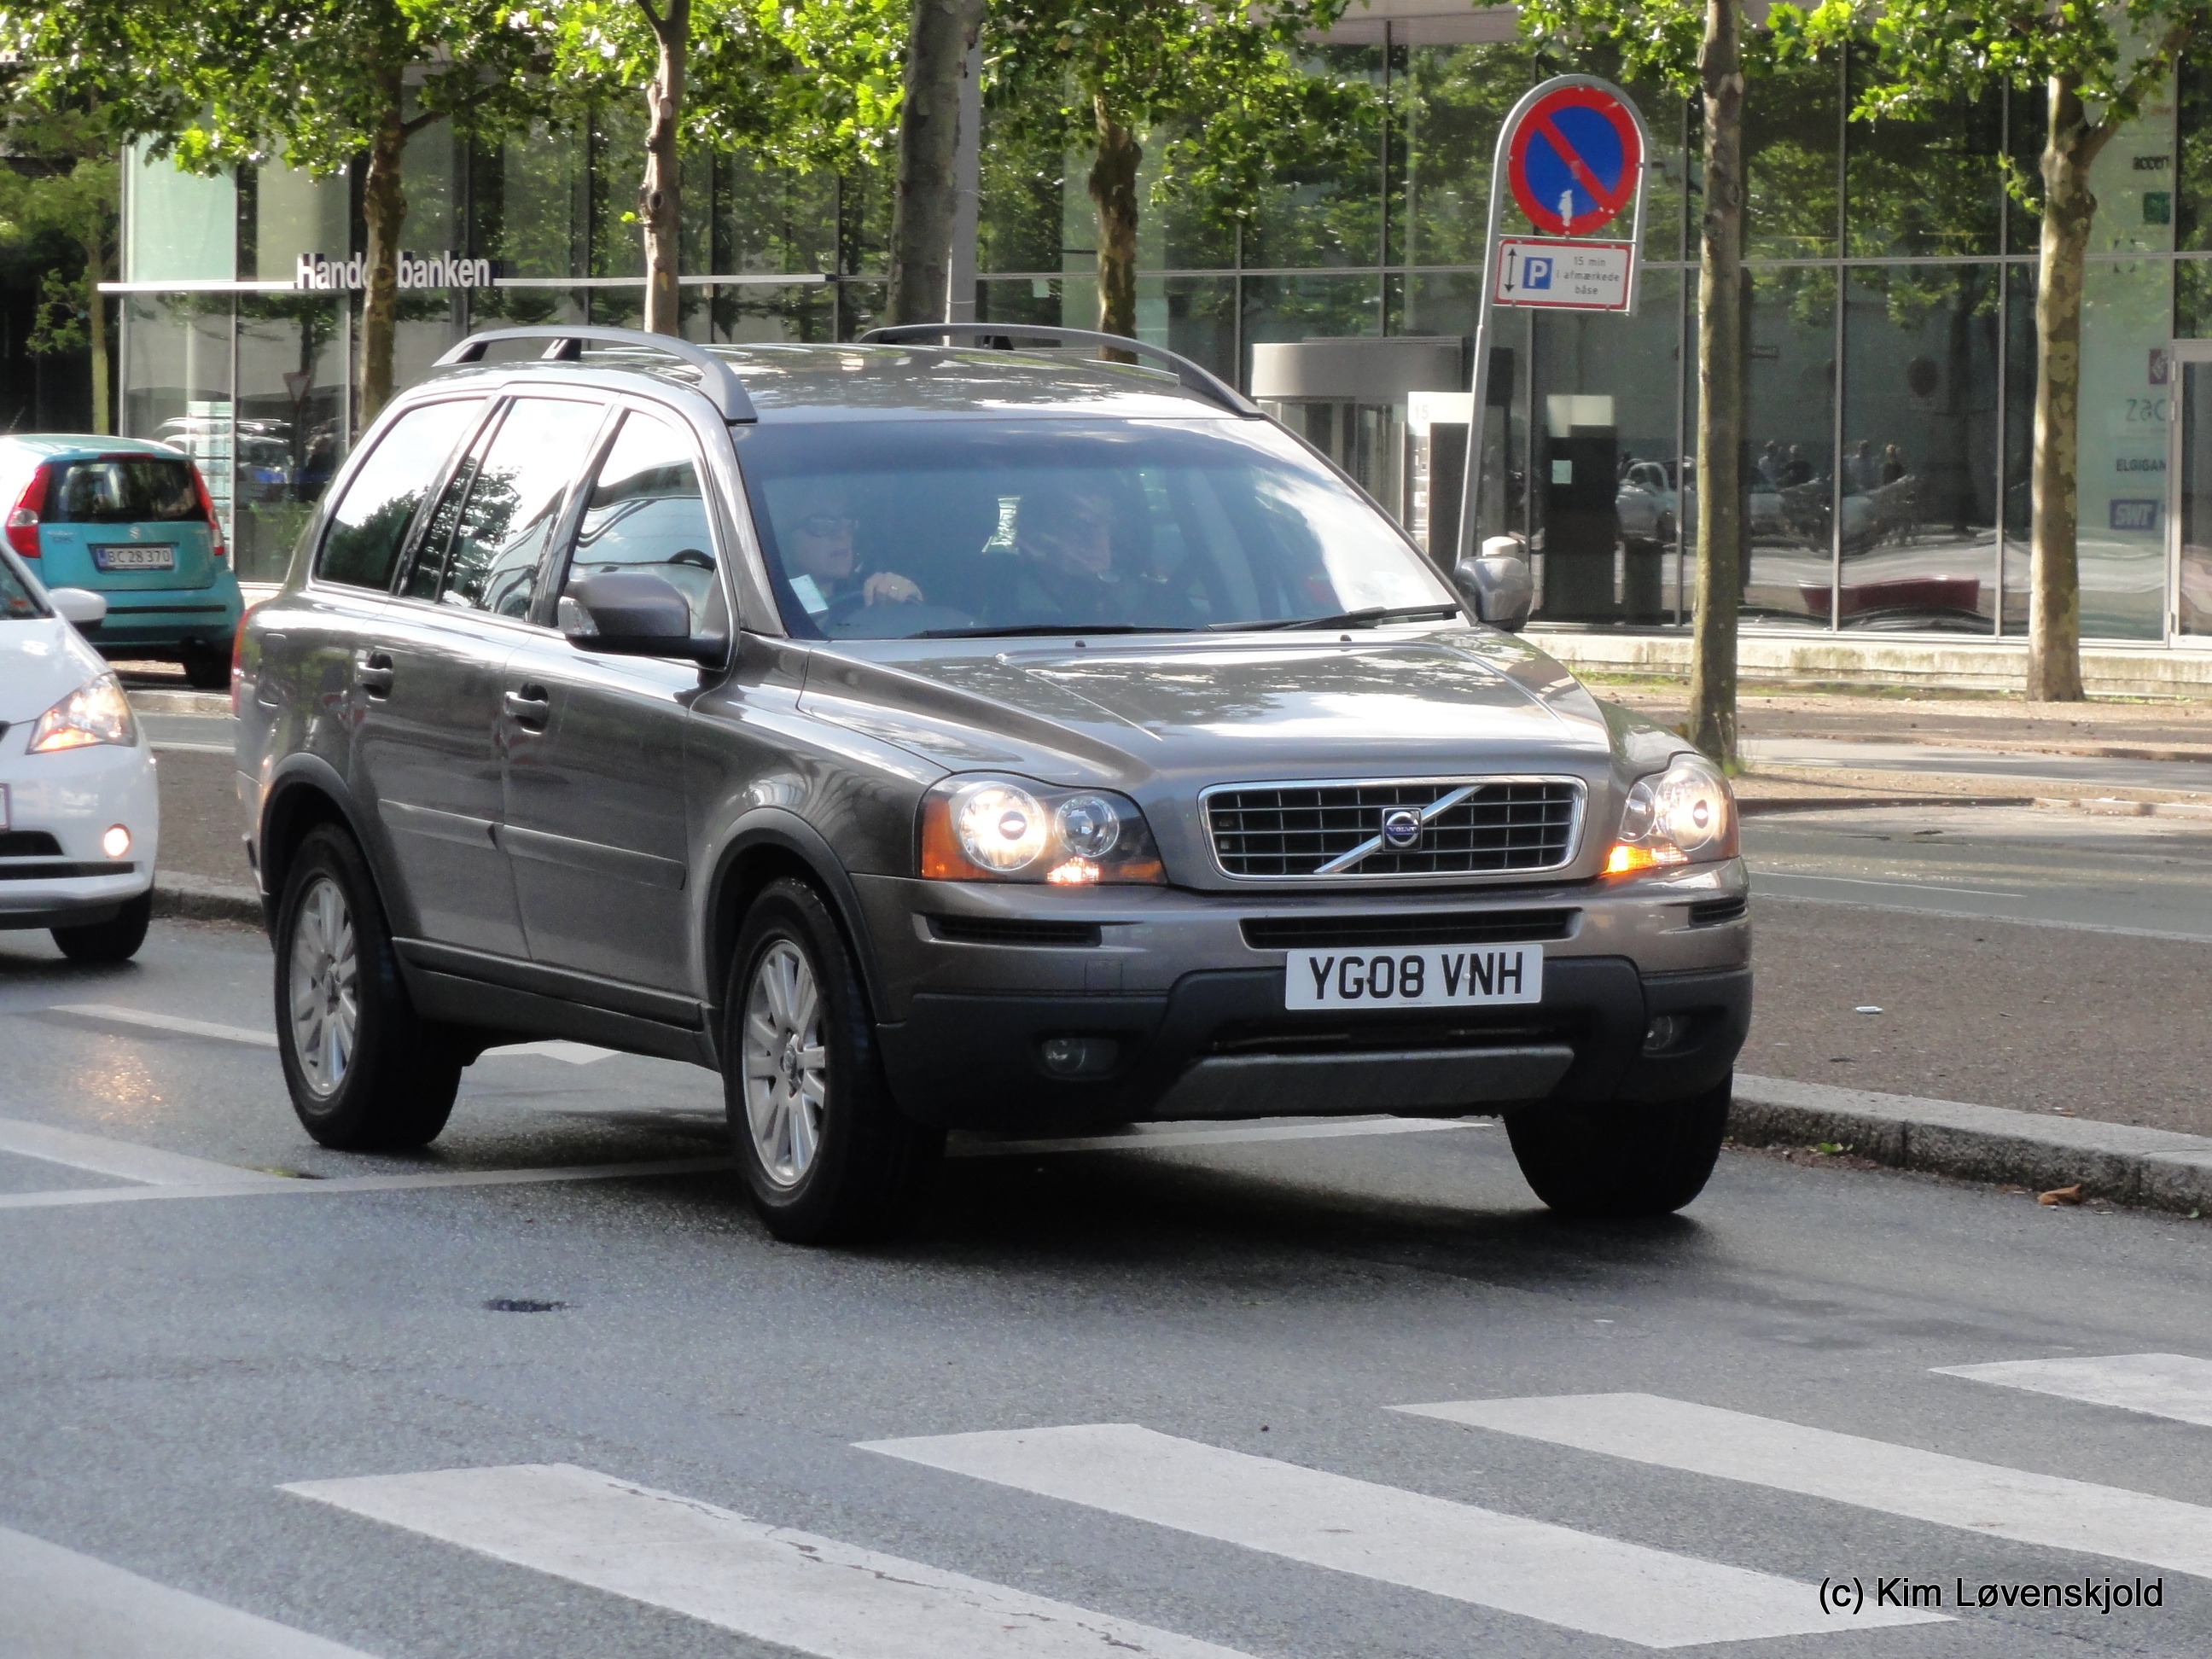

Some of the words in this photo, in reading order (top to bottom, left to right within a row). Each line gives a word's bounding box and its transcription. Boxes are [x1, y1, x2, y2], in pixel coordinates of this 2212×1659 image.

[1574, 257, 1585, 266] 15
[1587, 258, 1606, 267] min
[297, 250, 491, 289] Handbanken
[1528, 260, 1548, 287] P
[1563, 270, 1621, 282] afmærkede
[1575, 285, 1598, 295] båse
[1414, 405, 1429, 420] 15
[108, 551, 125, 563] BC
[128, 551, 144, 564] 28
[148, 550, 171, 563] 370
[1308, 955, 1425, 1000] YG08
[1441, 951, 1523, 998] VNH
